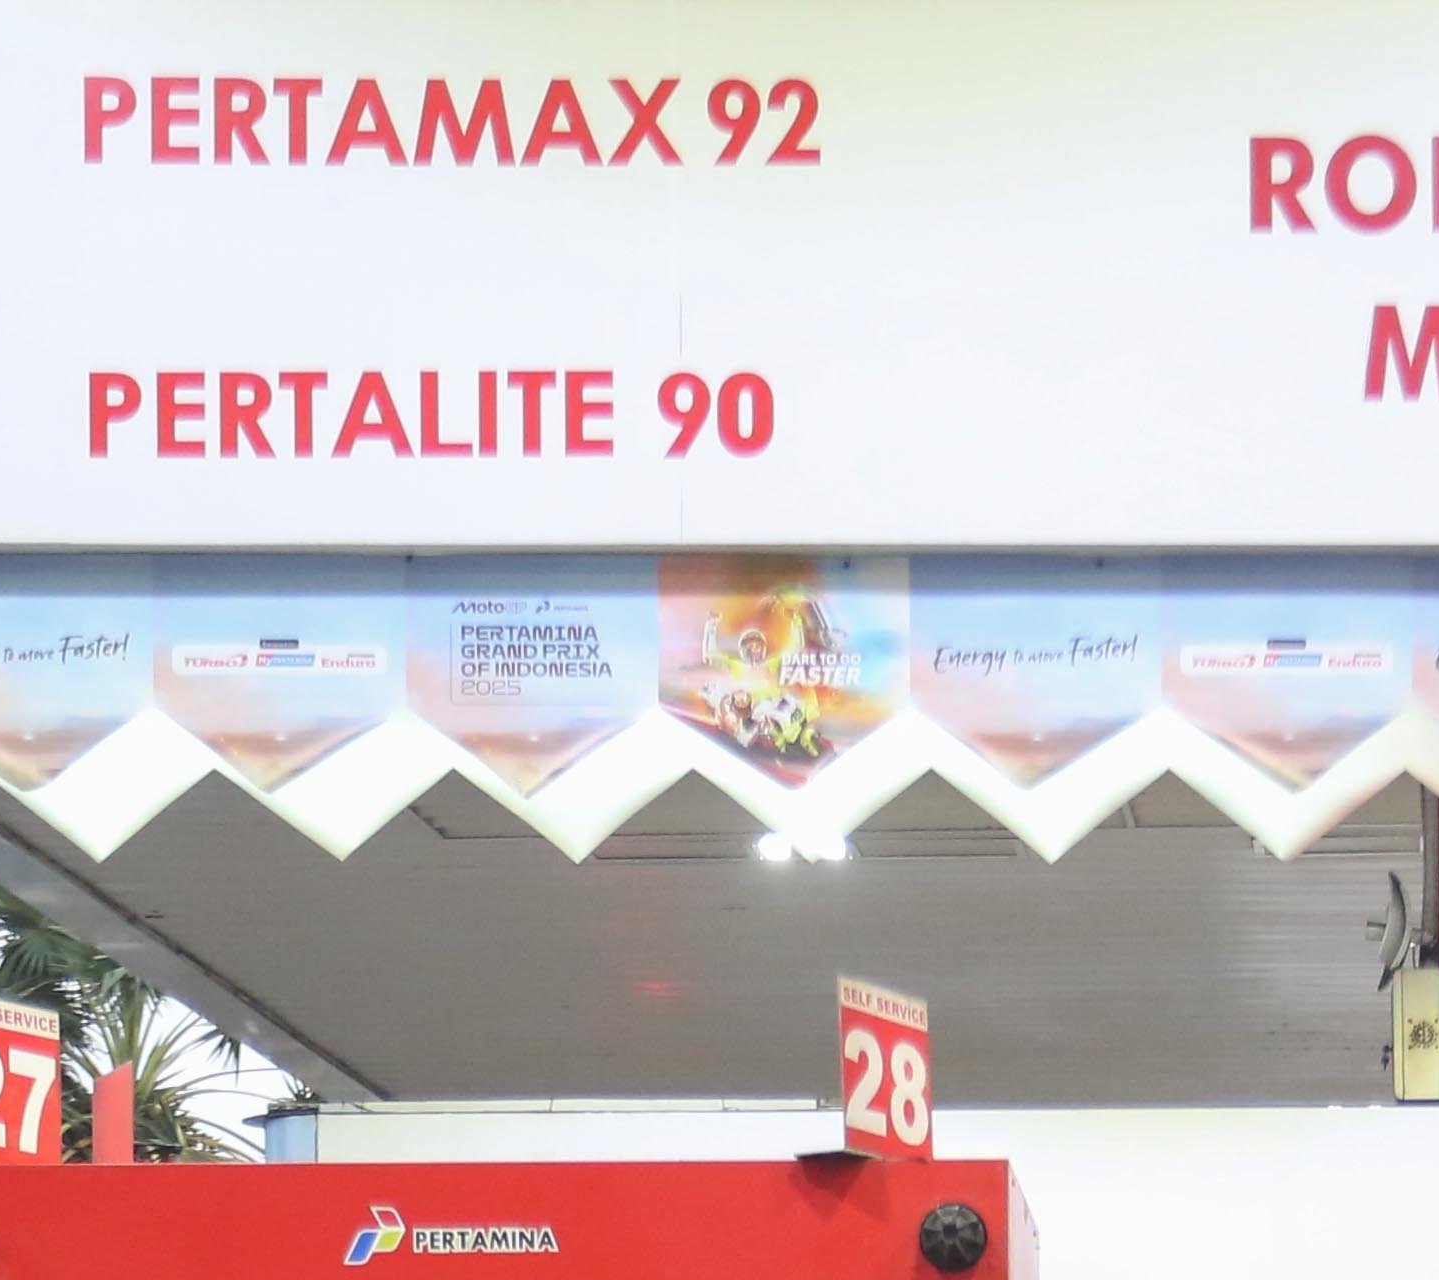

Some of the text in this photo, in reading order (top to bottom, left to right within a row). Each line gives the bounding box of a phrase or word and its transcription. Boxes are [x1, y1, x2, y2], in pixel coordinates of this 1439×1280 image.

[82, 77, 824, 167] PERTAMAX 92
[85, 369, 778, 460] PERTALITE 90
[59, 632, 130, 664] Faster!
[841, 985, 928, 1027] SELF SERVICE
[843, 1029, 931, 1147] 28
[412, 1226, 559, 1256] PERTAMINA
